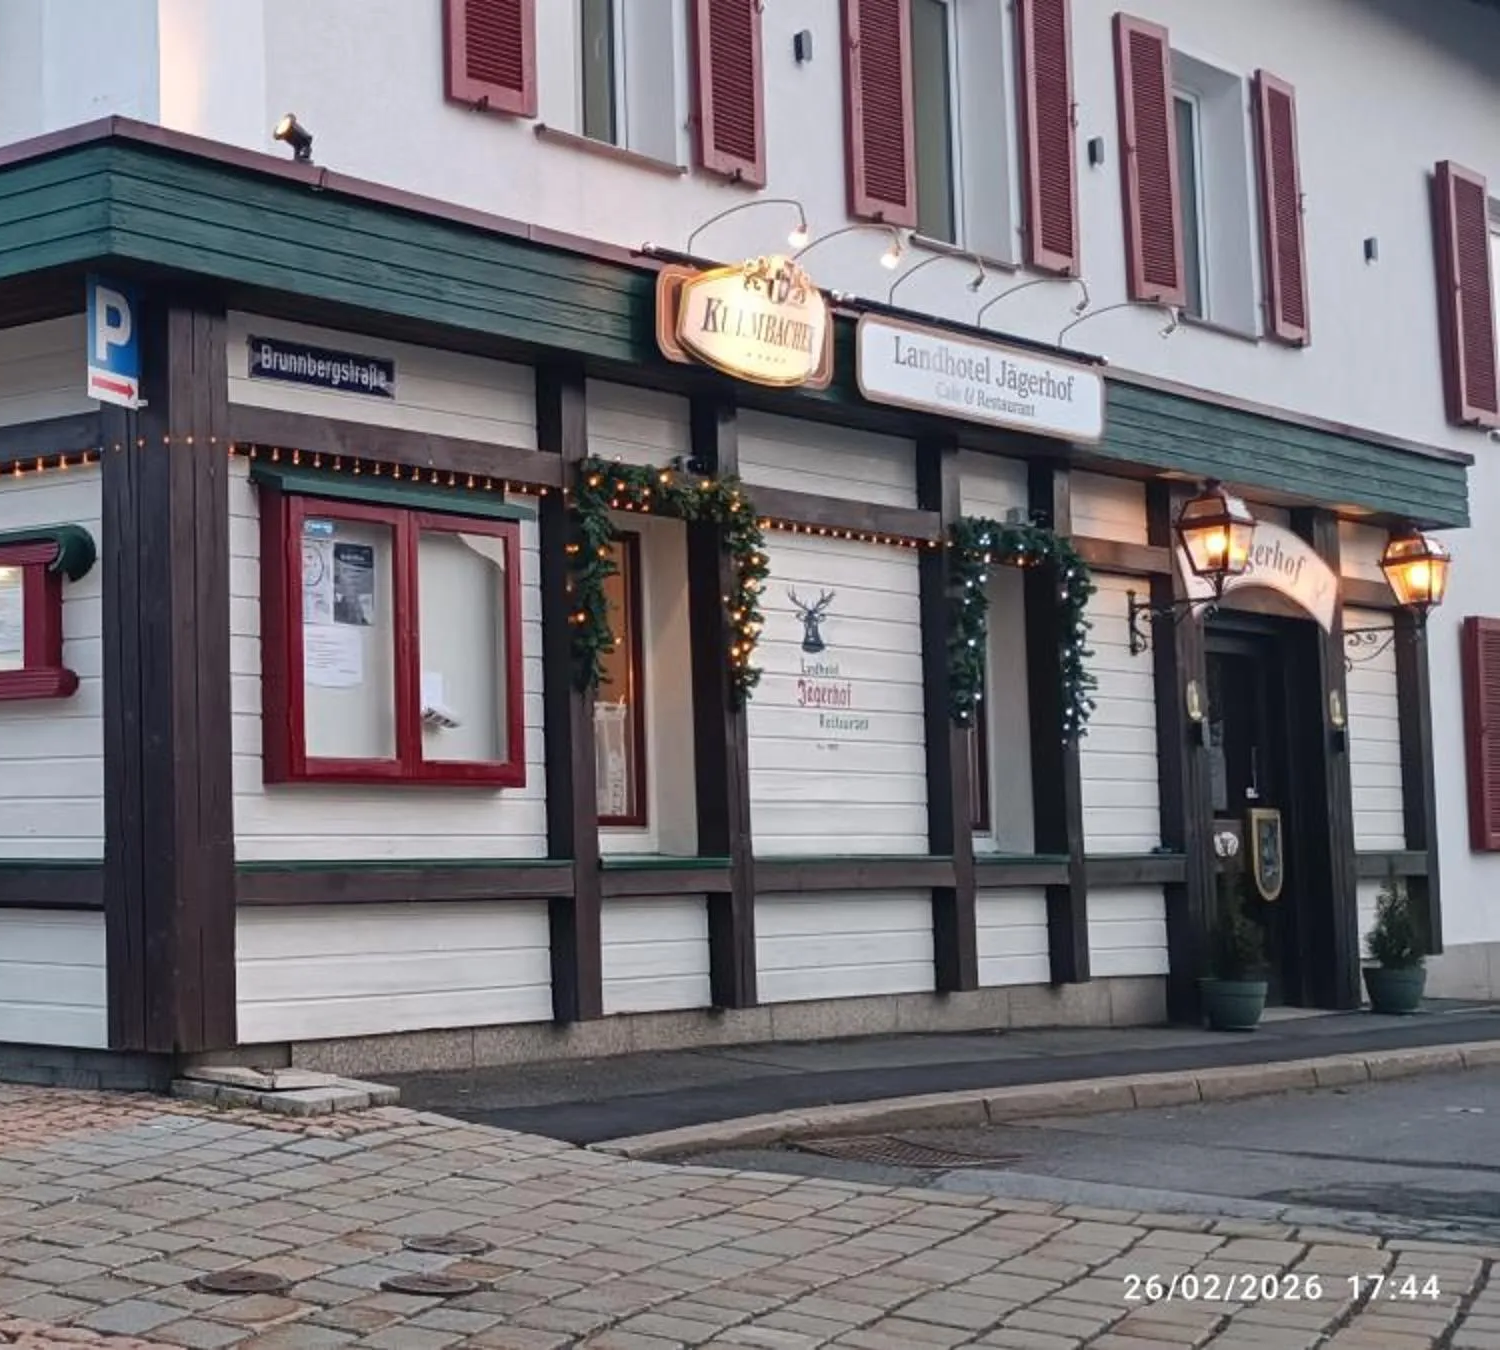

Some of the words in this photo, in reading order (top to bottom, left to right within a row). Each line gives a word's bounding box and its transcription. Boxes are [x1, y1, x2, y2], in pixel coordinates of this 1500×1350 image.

[96, 285, 132, 361] P
[261, 344, 387, 389] Brunnbergstraße
[893, 336, 990, 384] Landhotel
[996, 360, 1074, 401] Jägerhof
[977, 389, 1036, 416] Restaurant
[797, 678, 852, 709] Jägerhof
